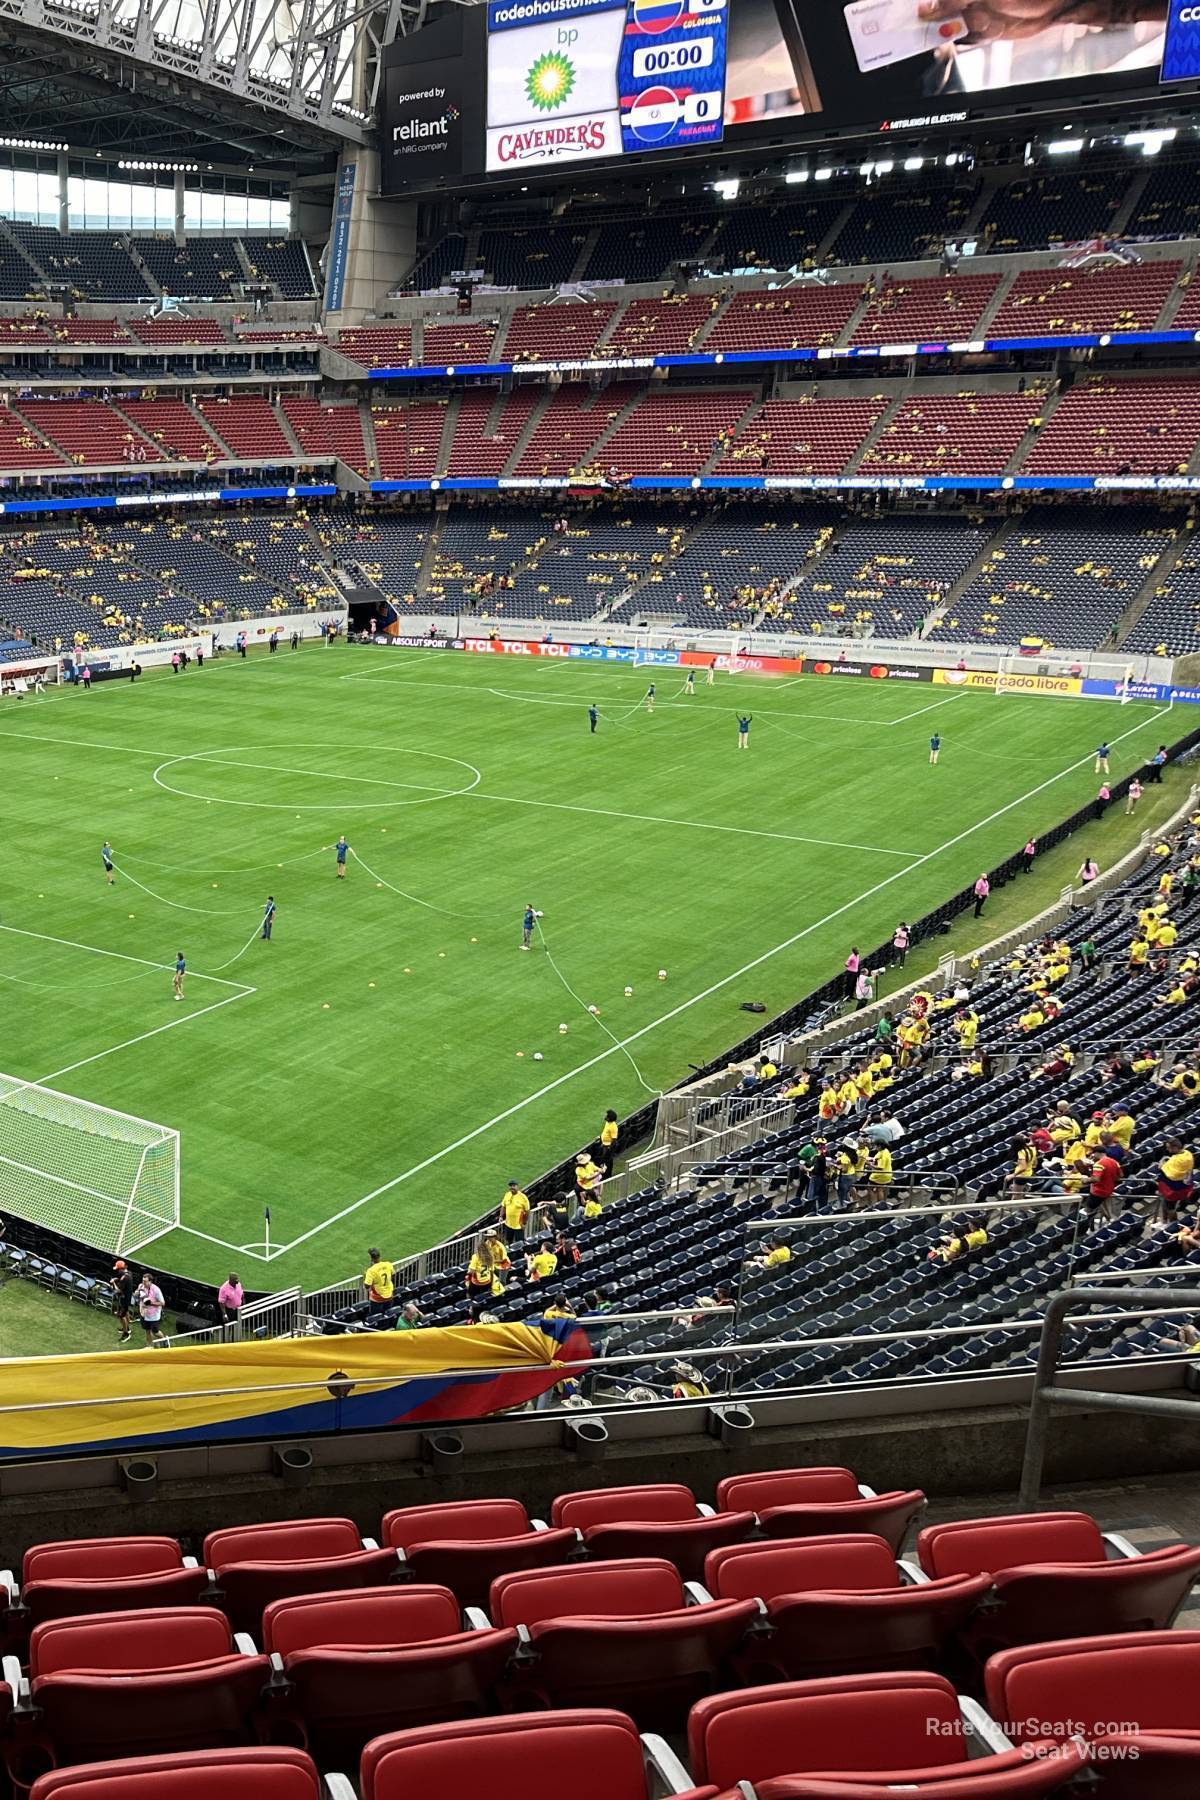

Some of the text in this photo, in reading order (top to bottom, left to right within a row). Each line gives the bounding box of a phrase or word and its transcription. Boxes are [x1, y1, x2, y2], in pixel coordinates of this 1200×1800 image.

[683, 15, 721, 29] COLOMBIA
[558, 28, 578, 46] bp
[645, 45, 702, 71] 00:00
[400, 87, 445, 104] powered by
[696, 99, 708, 117] 0
[890, 112, 967, 129] MITSUBISHI ELECTRIC
[393, 115, 448, 141] reliant
[402, 146, 417, 154] NRG
[418, 141, 448, 154] company
[497, 121, 605, 162] CAVENDER'S
[392, 638, 422, 646] ABSOLUT
[423, 639, 448, 648] SPORT
[467, 640, 495, 652] TCL
[502, 642, 531, 654] TCL
[539, 644, 569, 656] TCL
[570, 647, 597, 657] BYD
[607, 649, 639, 659] BYD
[644, 652, 678, 662] BYD
[972, 674, 1068, 690] mercado libre
